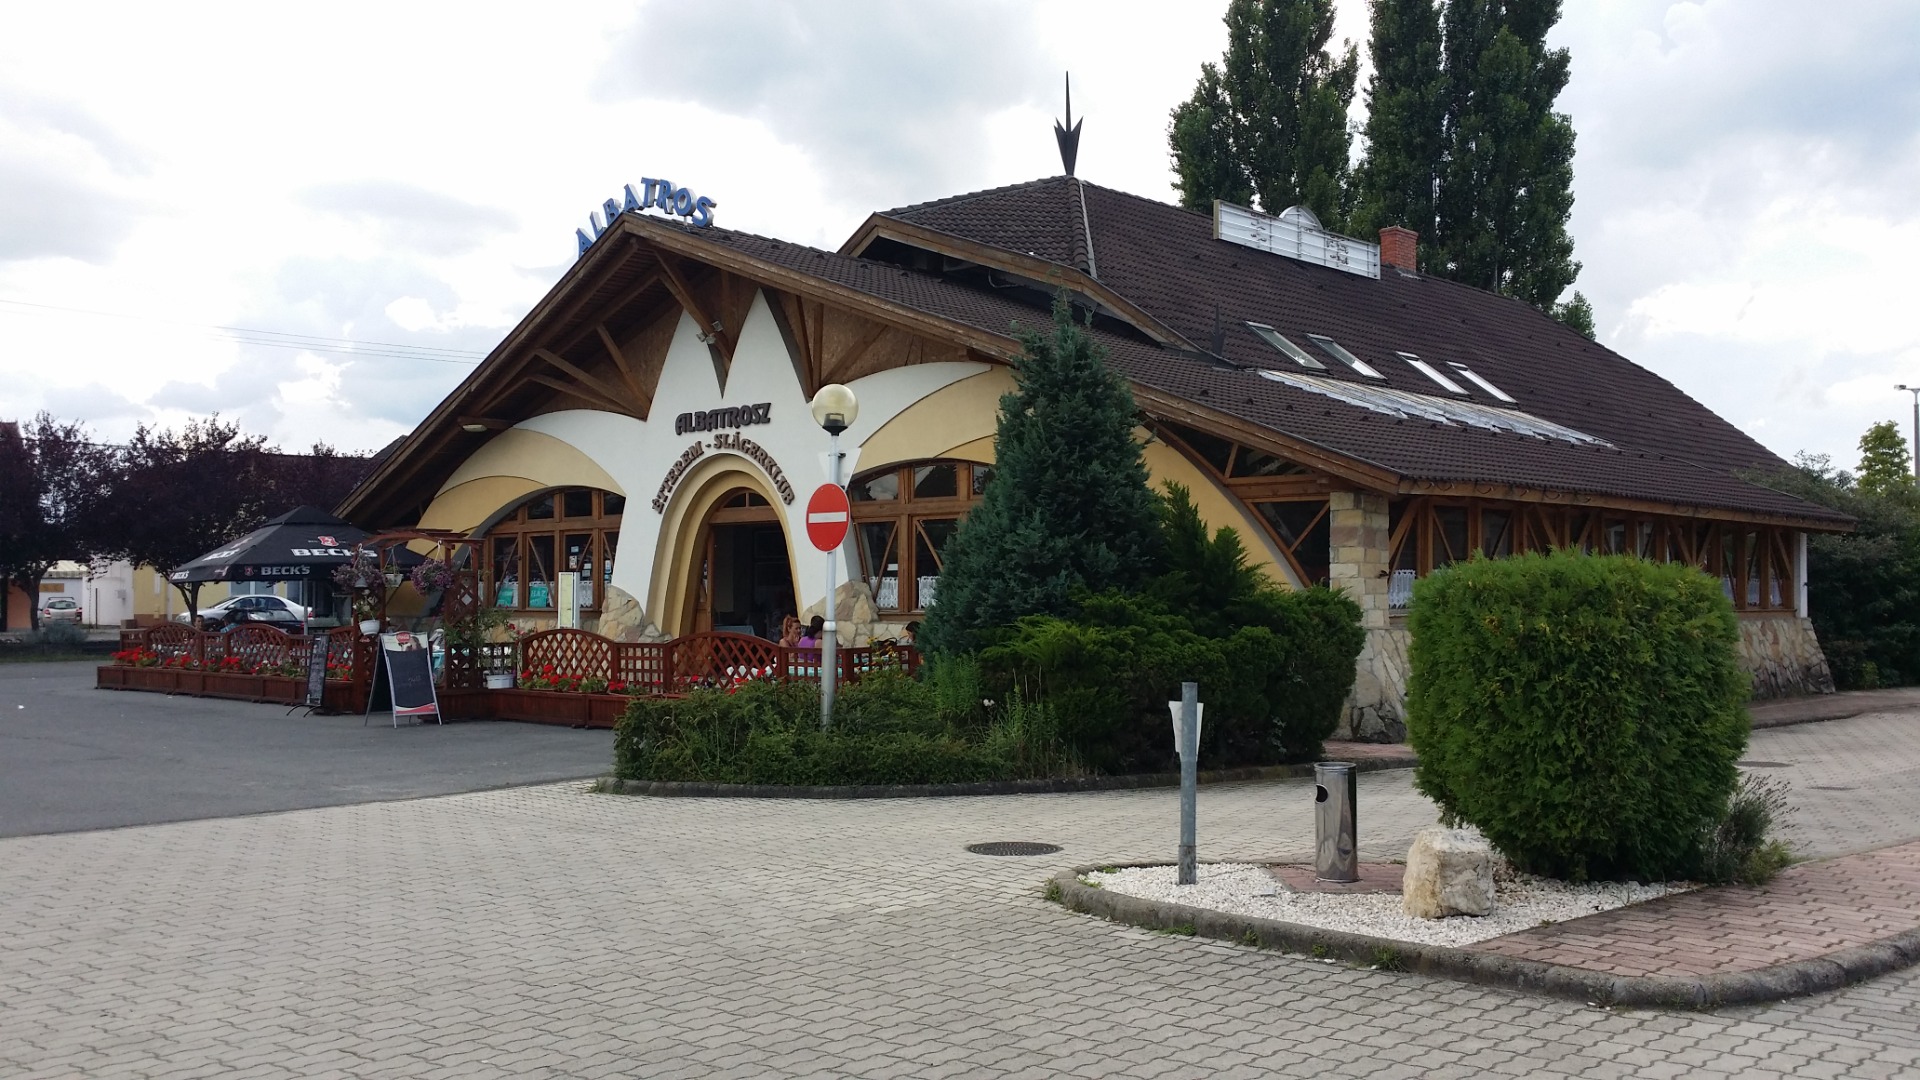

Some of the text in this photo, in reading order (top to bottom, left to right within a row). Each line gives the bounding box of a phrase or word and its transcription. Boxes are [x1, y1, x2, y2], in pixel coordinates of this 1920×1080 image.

[575, 176, 717, 258] ALBATROS
[675, 402, 771, 436] ALBATROSZ
[652, 440, 704, 514] ÉTTEREM
[713, 431, 796, 505] SLÁGERKLUB
[291, 548, 378, 557] BECKS
[261, 564, 311, 576] BECK'S
